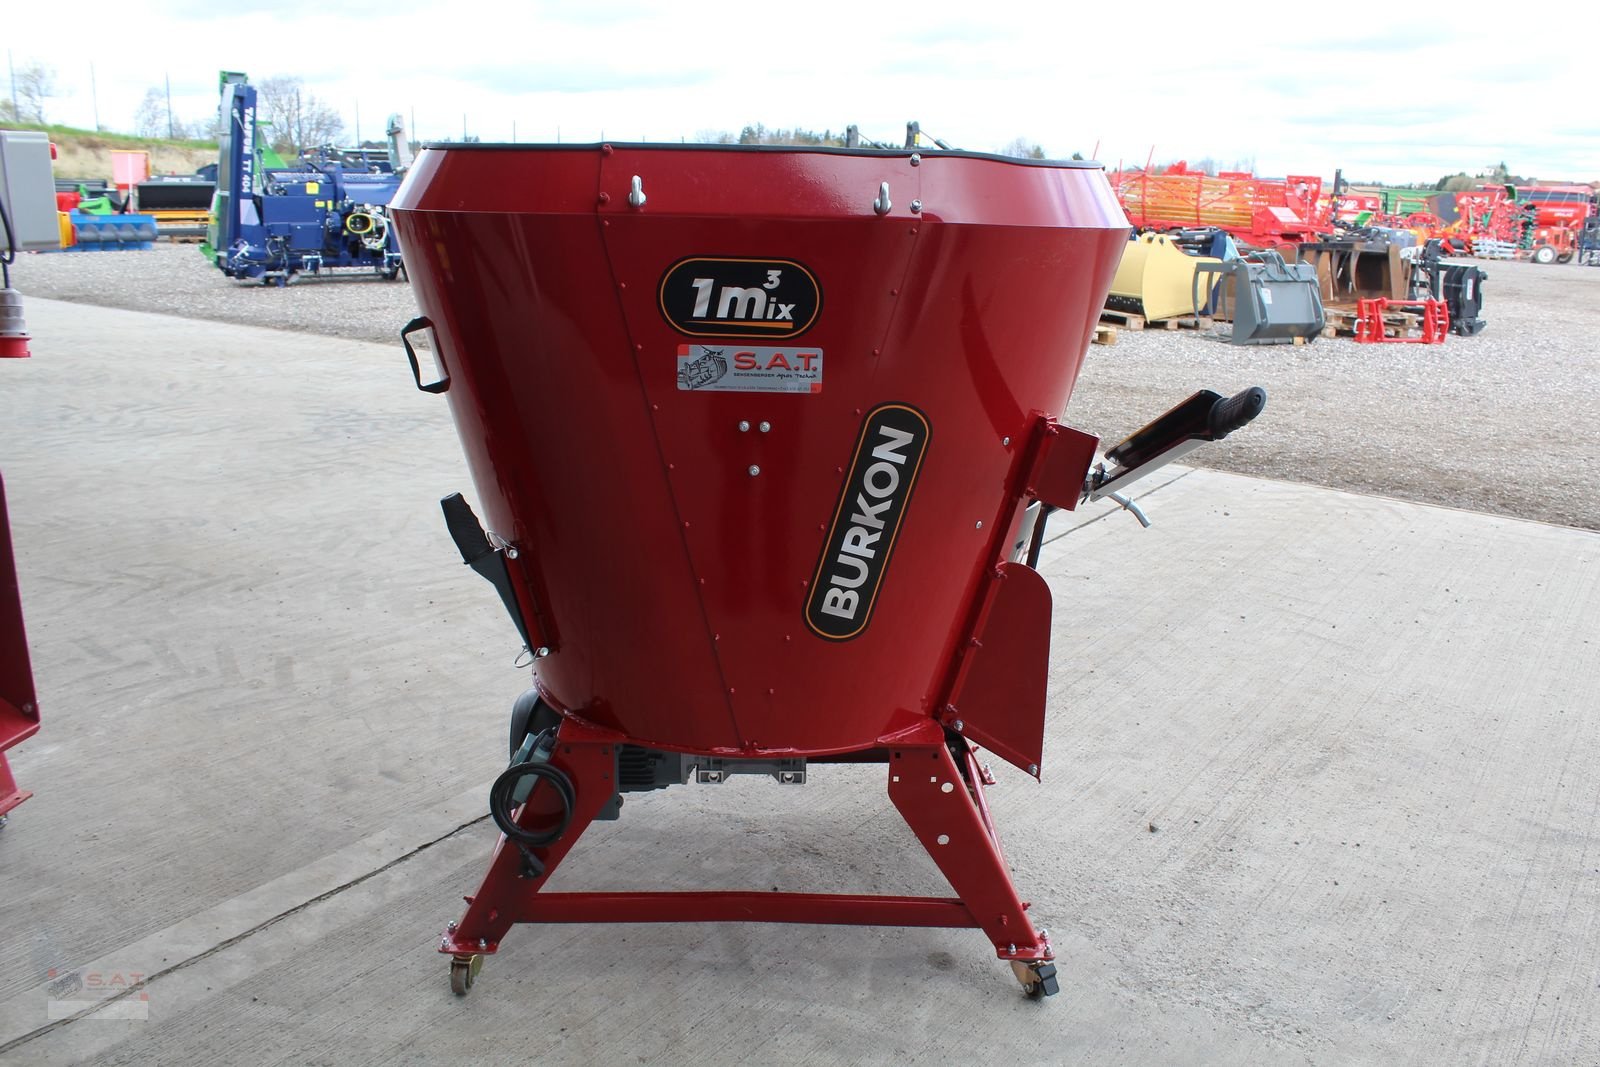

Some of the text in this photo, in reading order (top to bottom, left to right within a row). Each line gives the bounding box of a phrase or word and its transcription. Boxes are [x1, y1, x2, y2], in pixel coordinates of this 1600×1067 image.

[242, 159, 252, 173] TT
[734, 350, 818, 372] S.A.T.
[820, 425, 914, 620] BURKON
